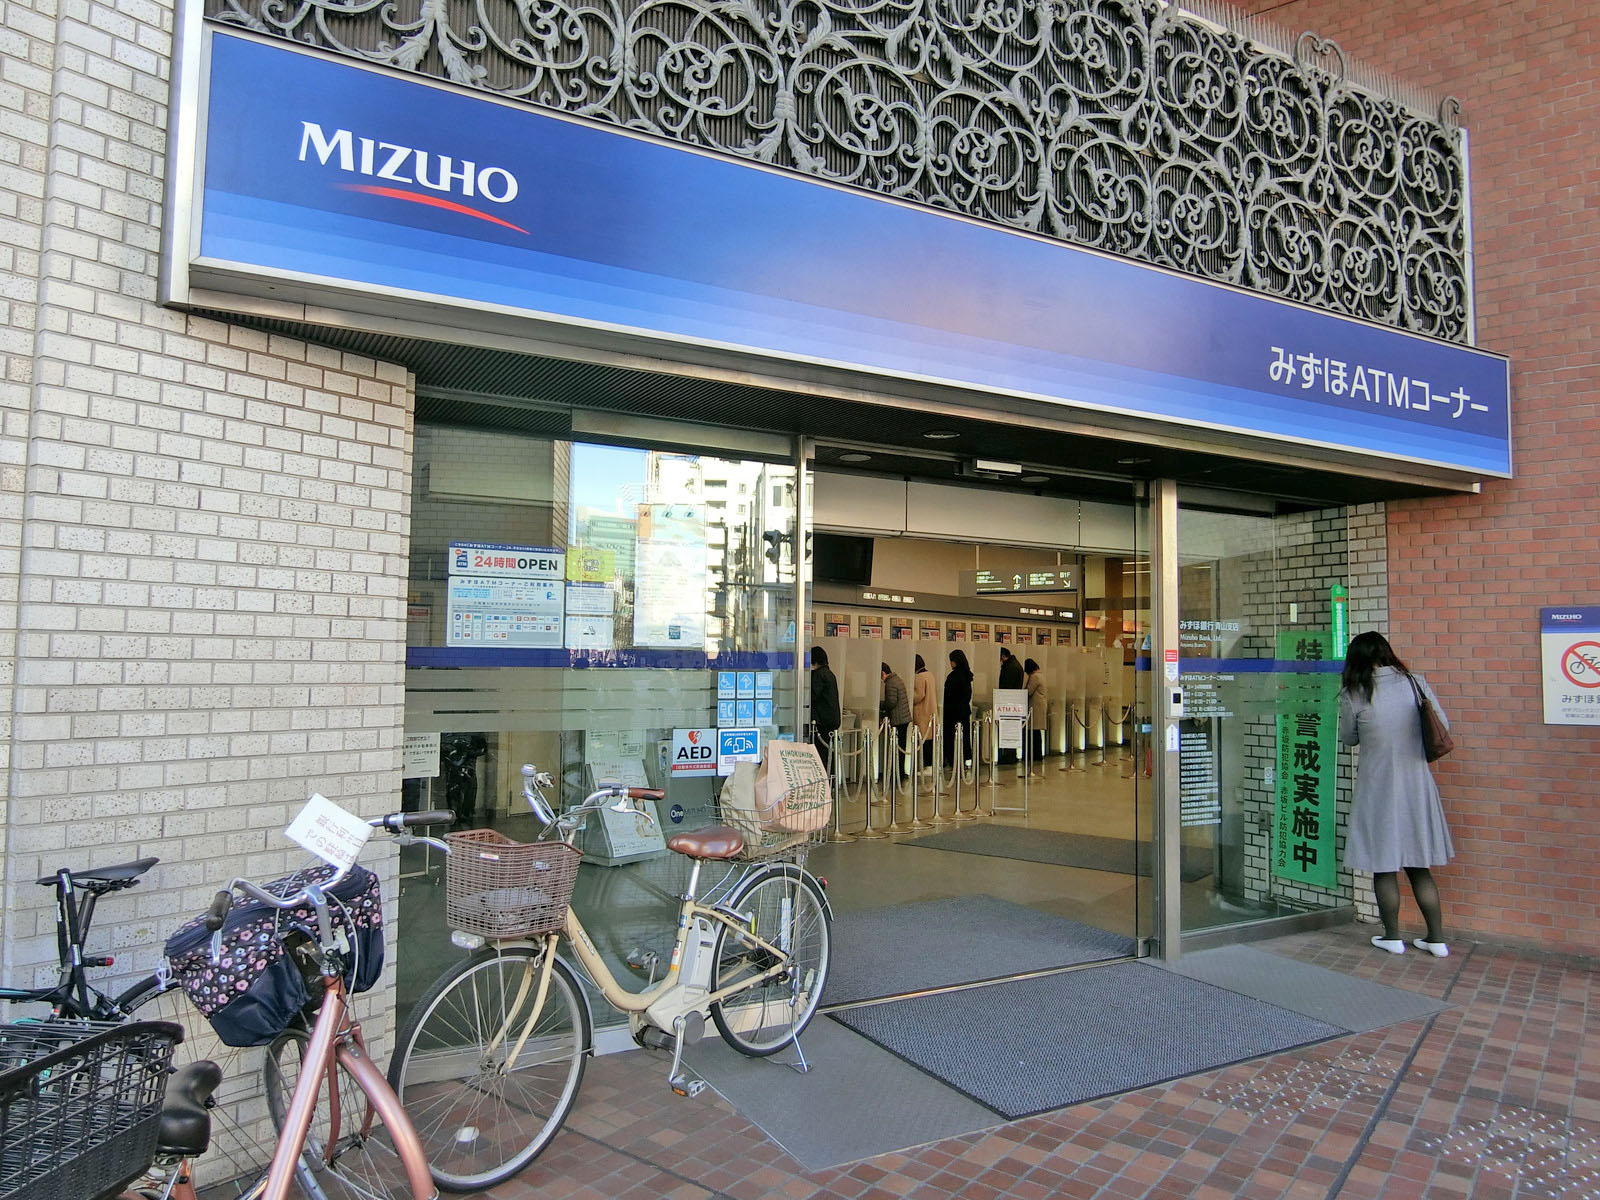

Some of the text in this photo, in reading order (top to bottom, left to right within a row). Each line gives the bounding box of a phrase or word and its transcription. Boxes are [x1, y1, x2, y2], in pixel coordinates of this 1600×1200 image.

[298, 120, 520, 204] MIZUHO
[1269, 346, 1489, 419] みずほATMコーナー
[474, 555, 558, 571] 24時間OPEN
[1179, 620, 1215, 632] みずほ銀行
[1180, 633, 1199, 642] Mizuho
[676, 746, 712, 760] AED
[1291, 638, 1322, 873] 特警戒実施中
[670, 810, 684, 818] One
